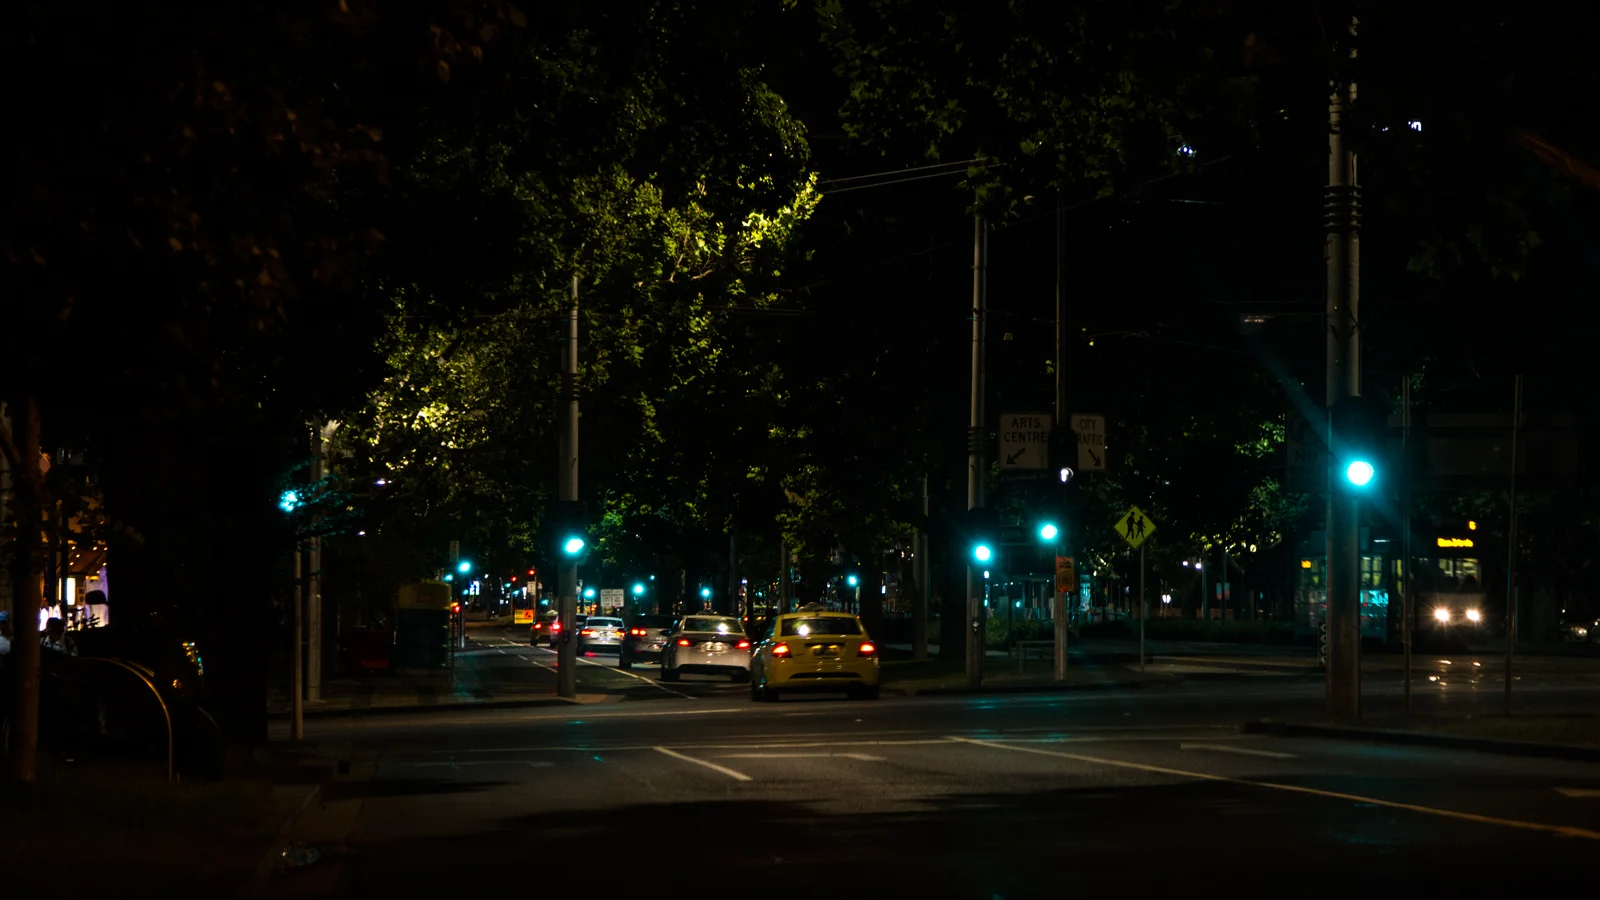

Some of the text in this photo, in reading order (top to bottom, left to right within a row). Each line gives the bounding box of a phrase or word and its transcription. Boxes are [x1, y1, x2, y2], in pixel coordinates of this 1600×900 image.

[1011, 416, 1041, 429] ARTS
[1079, 418, 1096, 431] CITY
[1003, 431, 1048, 443] CENTRE
[1077, 433, 1103, 446] RAFFIC
